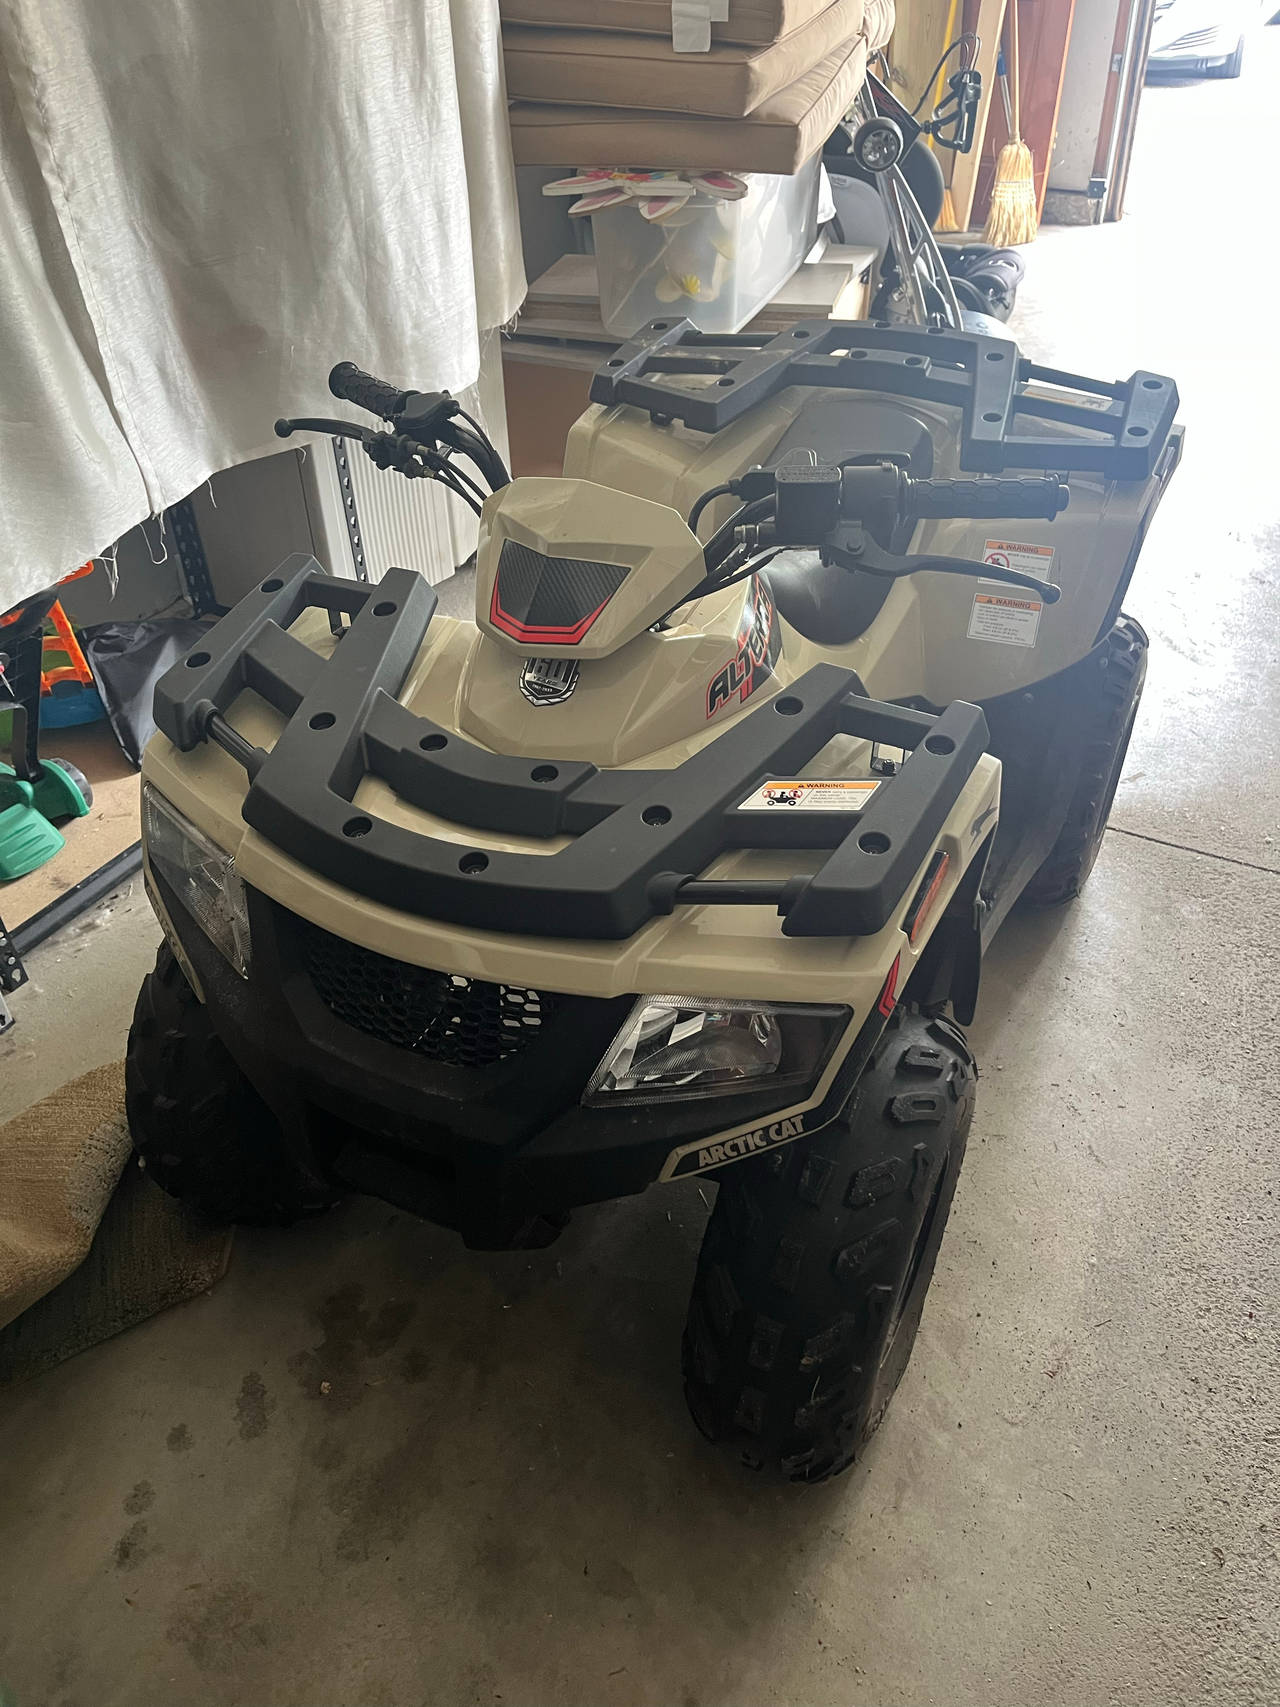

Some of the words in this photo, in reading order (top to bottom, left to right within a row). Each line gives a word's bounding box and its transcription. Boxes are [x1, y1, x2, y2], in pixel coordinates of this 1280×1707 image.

[1007, 544, 1039, 553] WARNING
[996, 599, 1031, 609] WARNING
[698, 1129, 767, 1168] ARCTIC
[769, 1115, 804, 1141] CAT
